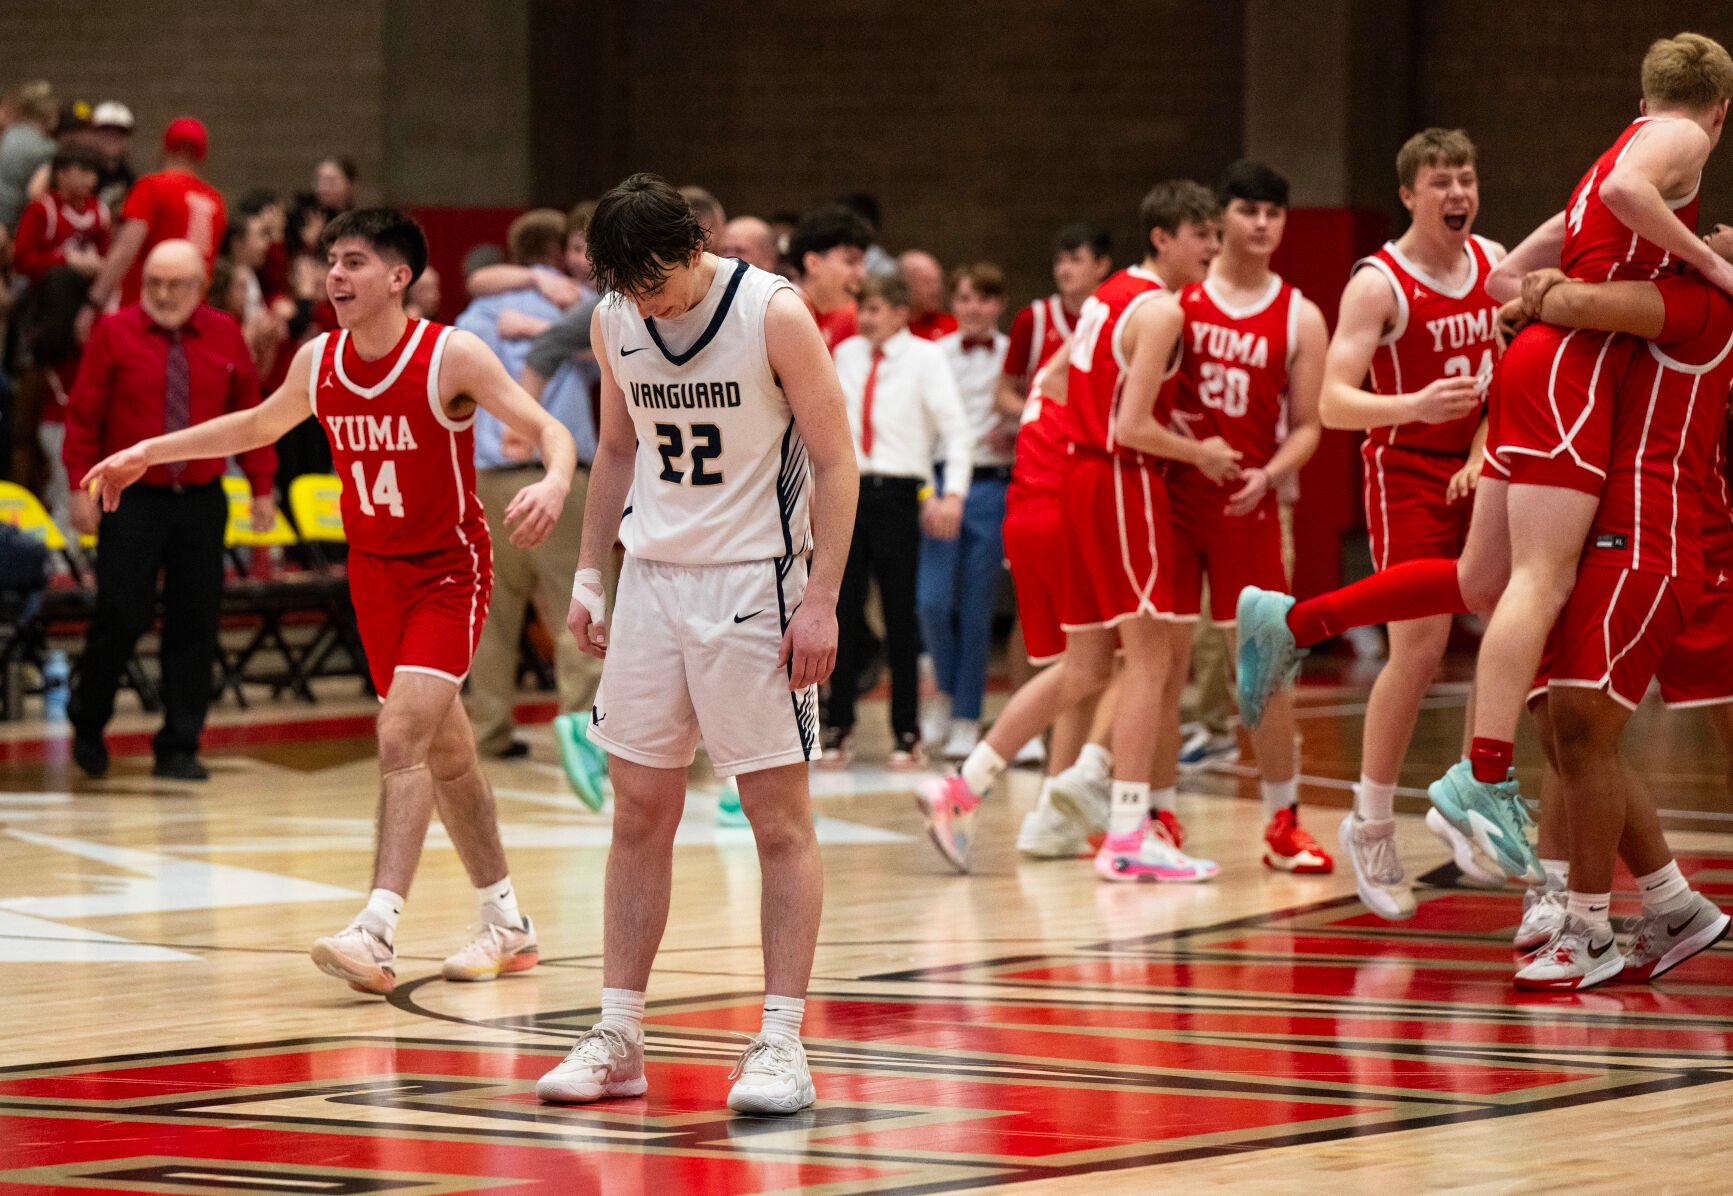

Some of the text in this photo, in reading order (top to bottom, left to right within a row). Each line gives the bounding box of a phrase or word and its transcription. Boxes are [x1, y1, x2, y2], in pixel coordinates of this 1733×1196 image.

[1190, 321, 1268, 369] YUMA
[630, 381, 741, 409] VANGUARD
[1198, 361, 1251, 418] 20
[326, 415, 418, 452] YUMA
[653, 421, 725, 488] 22
[351, 460, 405, 518] 14
